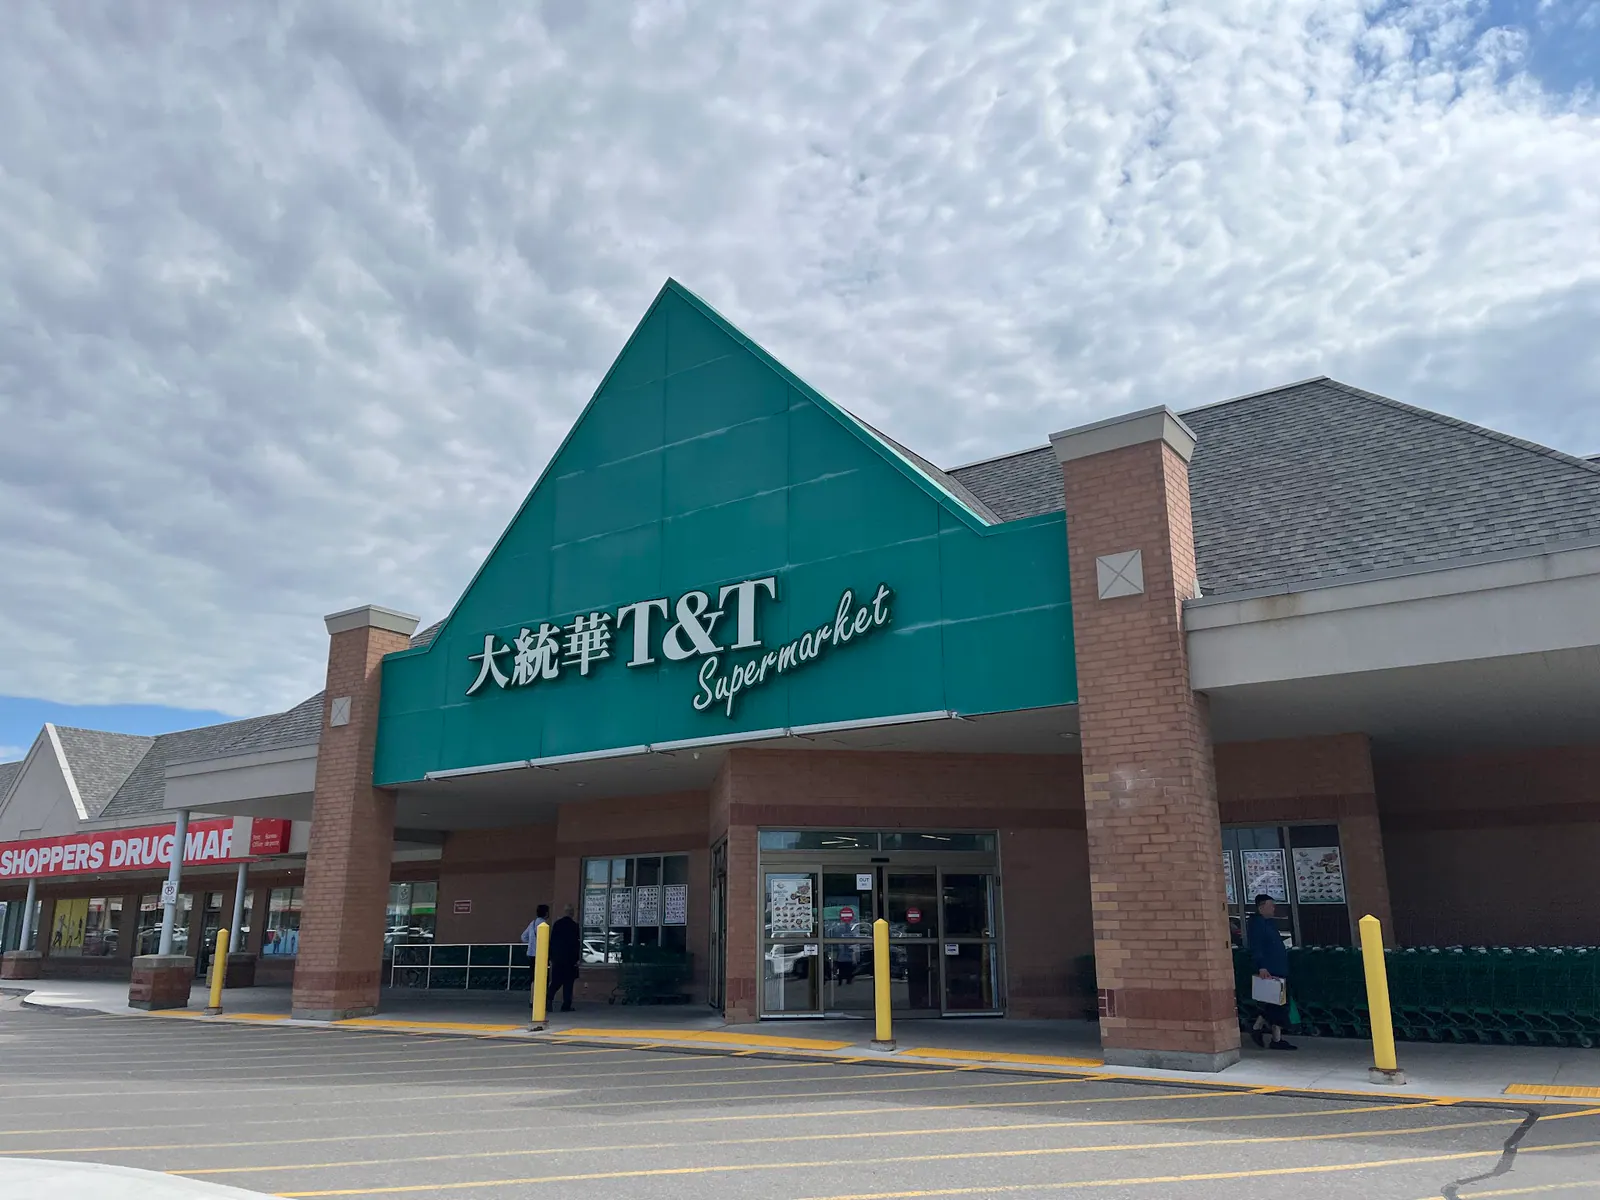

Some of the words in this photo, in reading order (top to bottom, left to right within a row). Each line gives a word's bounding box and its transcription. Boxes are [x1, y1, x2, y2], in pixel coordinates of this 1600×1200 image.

[465, 612, 612, 695] 大統華
[617, 576, 776, 667] T&T
[692, 584, 891, 716] Supermarket
[0, 841, 104, 876] SHOPPERS
[109, 834, 175, 867] DRUG
[183, 828, 233, 861] MAR
